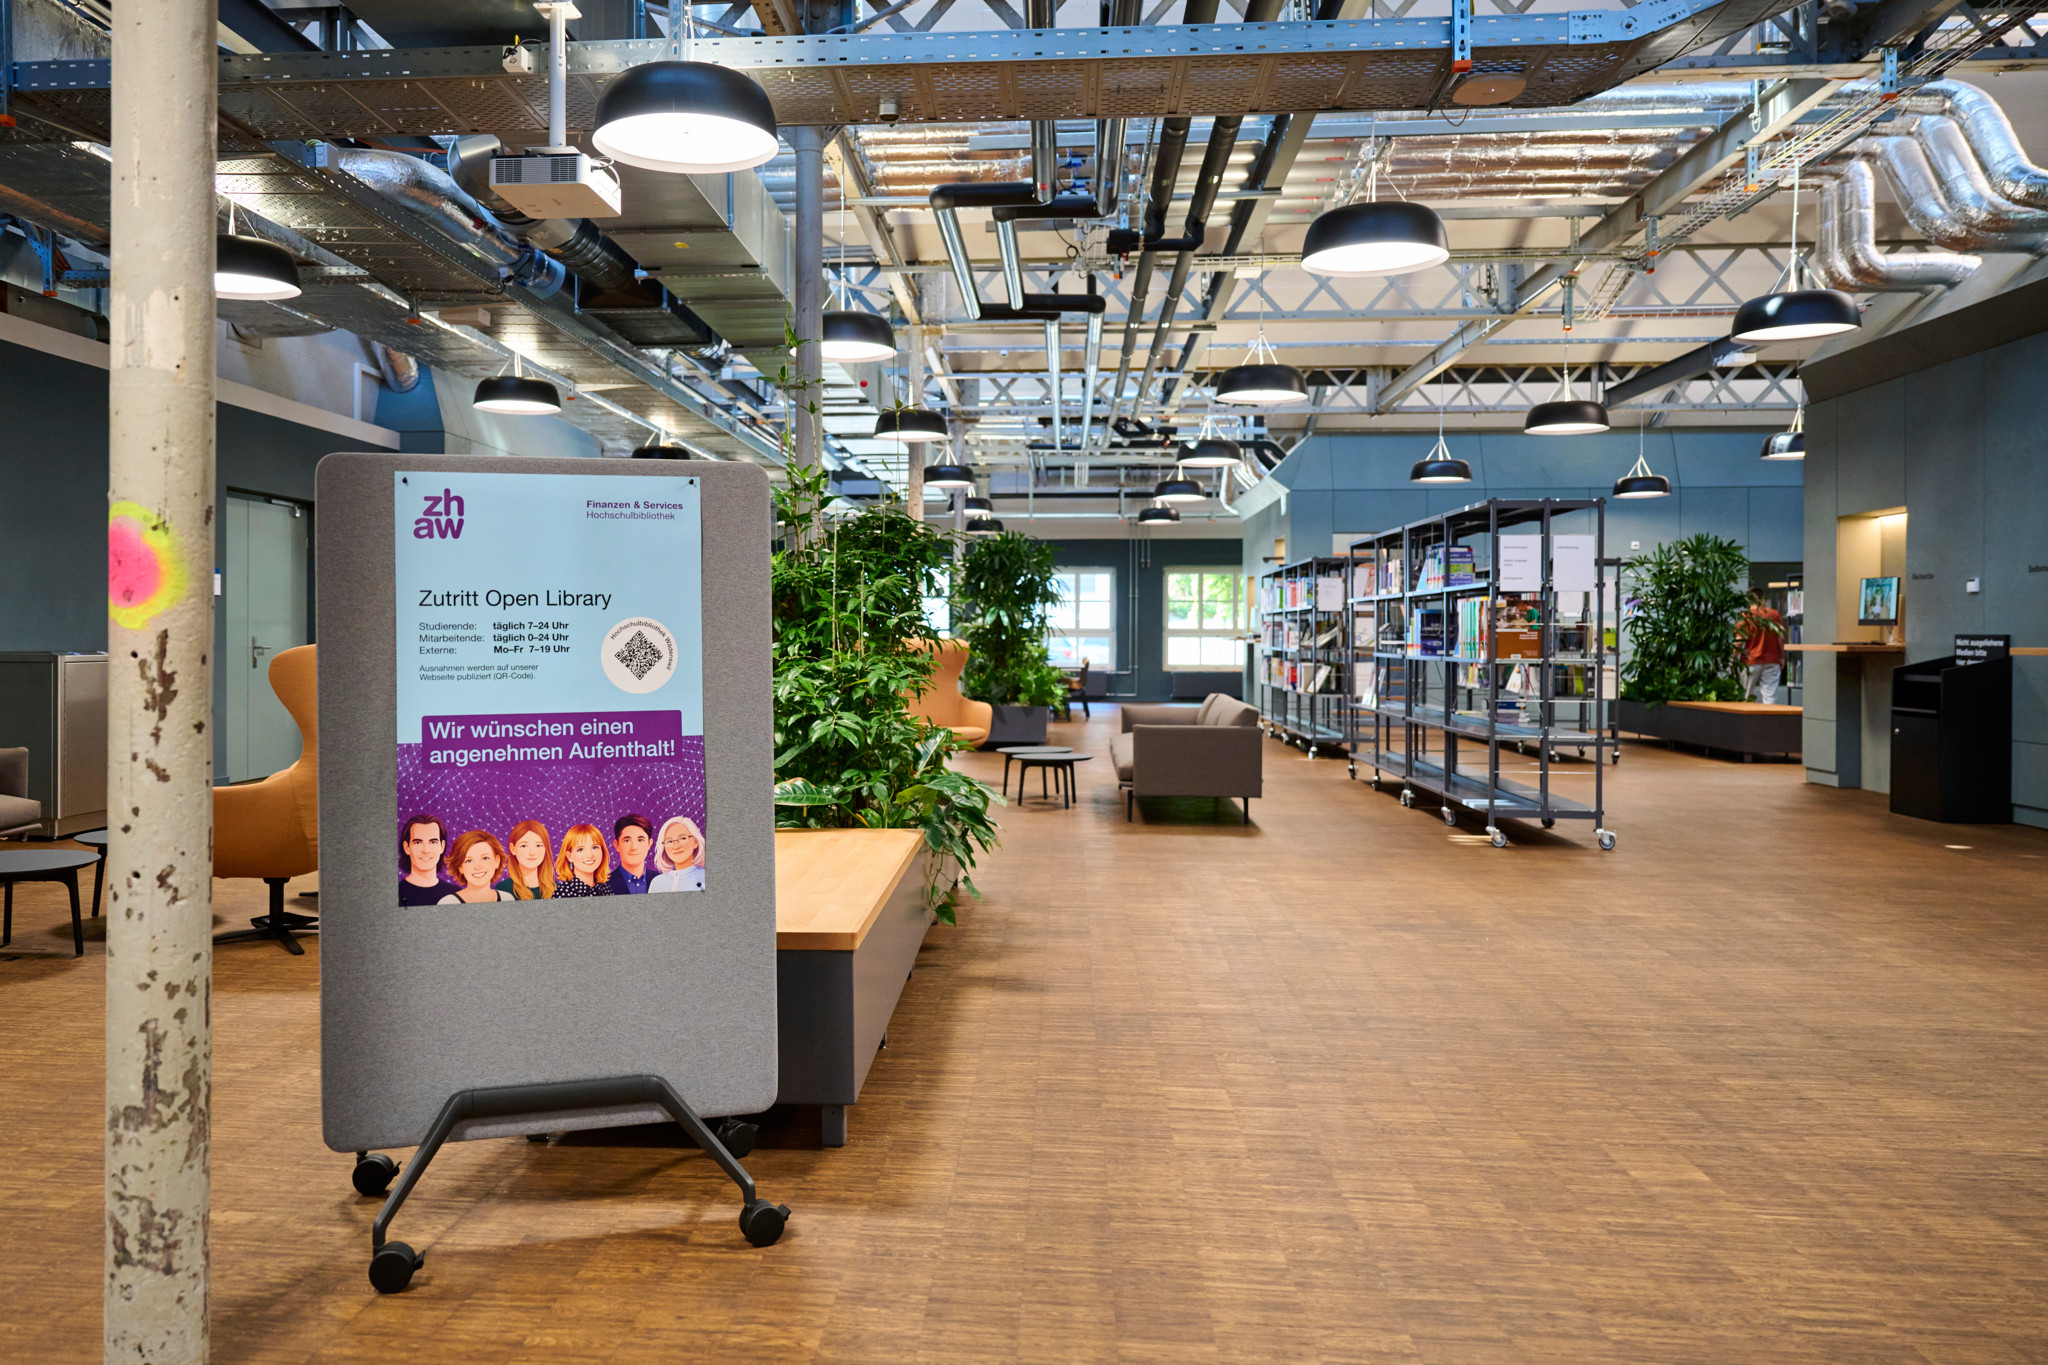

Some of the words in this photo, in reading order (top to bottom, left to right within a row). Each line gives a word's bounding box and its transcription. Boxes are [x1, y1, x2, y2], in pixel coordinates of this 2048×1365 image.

[586, 500, 631, 509] Finanzen
[633, 501, 640, 509] &
[643, 501, 683, 510] Services
[586, 510, 675, 520] Hochschulbibliothek
[419, 590, 479, 606] Zutritt
[485, 589, 539, 610] Open
[546, 589, 612, 610] Library
[419, 622, 476, 631] Studierende:
[493, 621, 525, 631] täglich
[552, 621, 569, 630] Uhr
[419, 634, 485, 643] Mitarbeitende:
[493, 633, 525, 643] täglich
[552, 633, 569, 642] Uhr
[1970, 639, 2004, 647] ausgeliehene
[419, 646, 457, 655] Externe:
[553, 645, 570, 653] Uhr
[610, 620, 667, 640] Hochschulbibliothek
[664, 637, 674, 671] Wädenswil
[419, 664, 465, 672] Ausnahmen
[419, 673, 455, 681] Webseite
[457, 673, 491, 681] publiziert
[493, 672, 536, 681] (QR-Code).
[429, 722, 465, 739] Wir
[471, 719, 574, 739] wünschen
[580, 718, 634, 735] einen
[429, 744, 563, 767] angenehmen
[569, 739, 675, 760] Aufenthalt!
